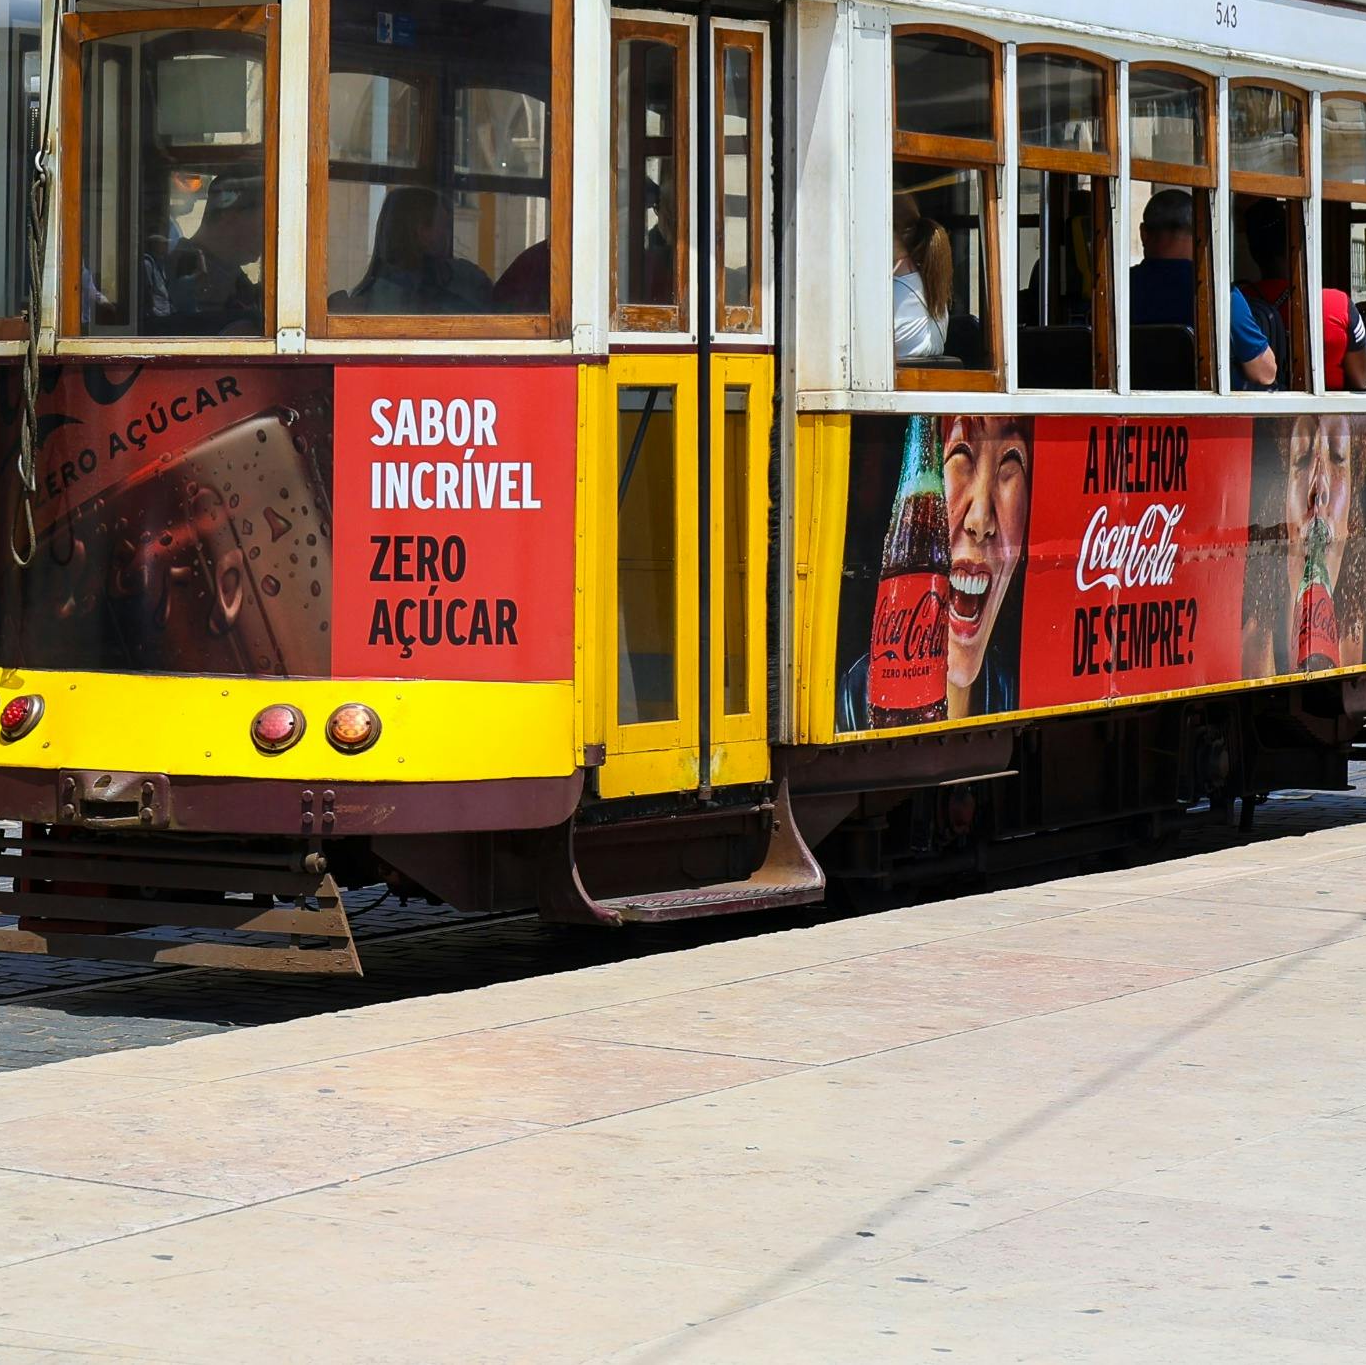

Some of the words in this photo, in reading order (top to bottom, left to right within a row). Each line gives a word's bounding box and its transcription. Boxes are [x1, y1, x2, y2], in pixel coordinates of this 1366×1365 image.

[1216, 1, 1237, 28] 543
[35, 448, 98, 505] ERO
[109, 375, 242, 459] AÇÚCAR
[370, 398, 497, 446] SABOR
[371, 448, 542, 510] INCRÍVEL
[1083, 426, 1099, 494] A
[1103, 425, 1189, 494] MELHOR
[369, 535, 467, 583] ZERO
[1076, 503, 1186, 592] Coca-Cola
[368, 585, 518, 659] AÇÚCAR
[1073, 605, 1102, 677] DE
[1102, 597, 1198, 675] SEMPRE?
[882, 668, 901, 678] ZERO
[903, 664, 930, 680] AÇÚCAR
